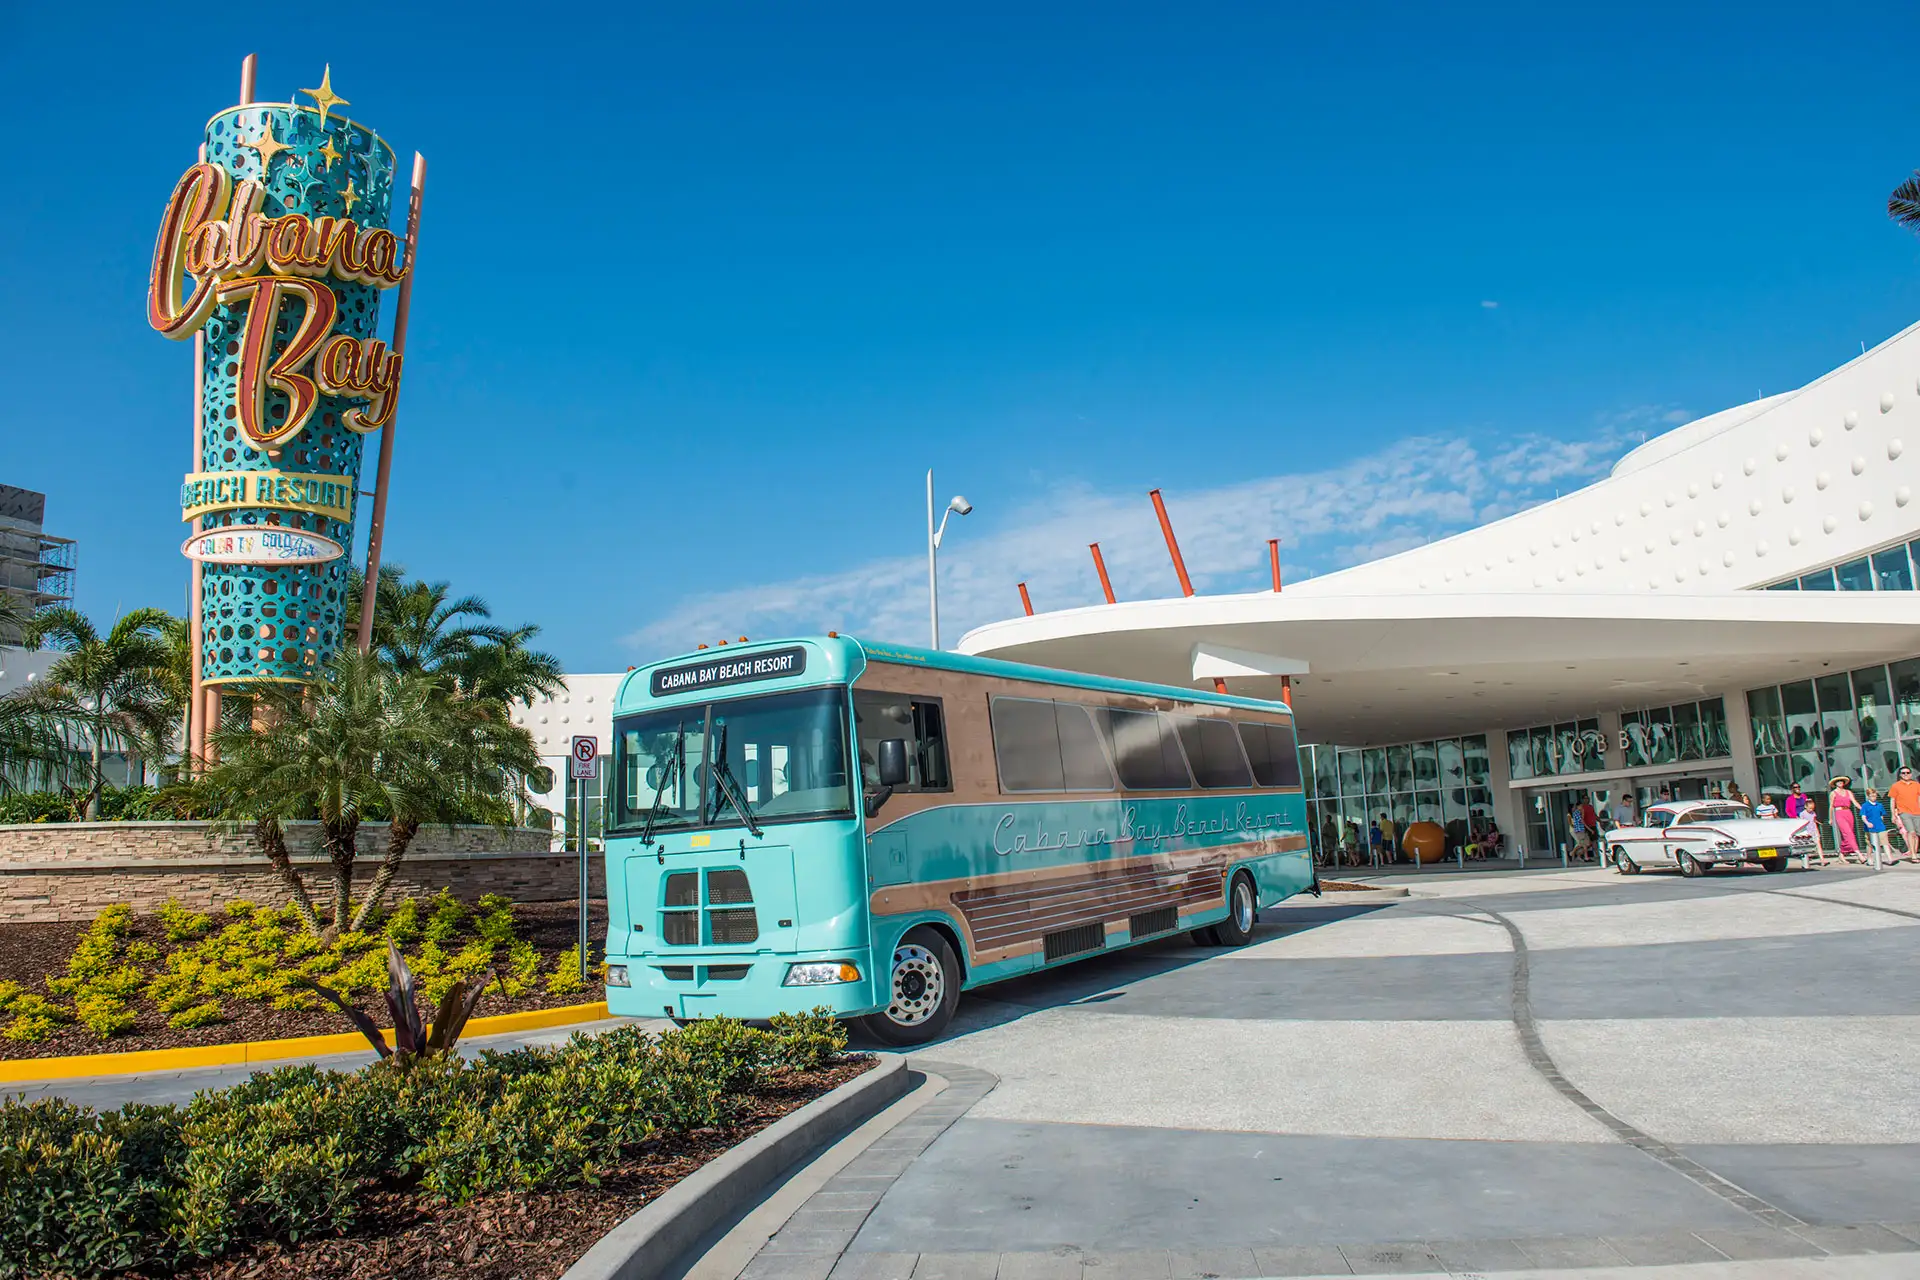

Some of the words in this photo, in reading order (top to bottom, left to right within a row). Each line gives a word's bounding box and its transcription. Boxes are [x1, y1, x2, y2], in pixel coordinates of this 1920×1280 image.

[148, 163, 409, 340] Cabana
[217, 275, 403, 450] Bay
[180, 476, 246, 509] BEACH
[256, 475, 350, 510] RESORT
[238, 536, 255, 554] TV
[262, 532, 292, 551] COLD
[279, 537, 317, 559] Air
[661, 670, 697, 689] CABANA
[699, 666, 718, 682] BAY
[719, 662, 752, 679] BEACH
[754, 655, 794, 673] RESORT
[1553, 727, 1653, 759] LOBBY
[993, 812, 1108, 856] Cabana
[1121, 806, 1169, 849] Bay
[1174, 803, 1234, 837] Beach
[1236, 801, 1293, 832] Resort
